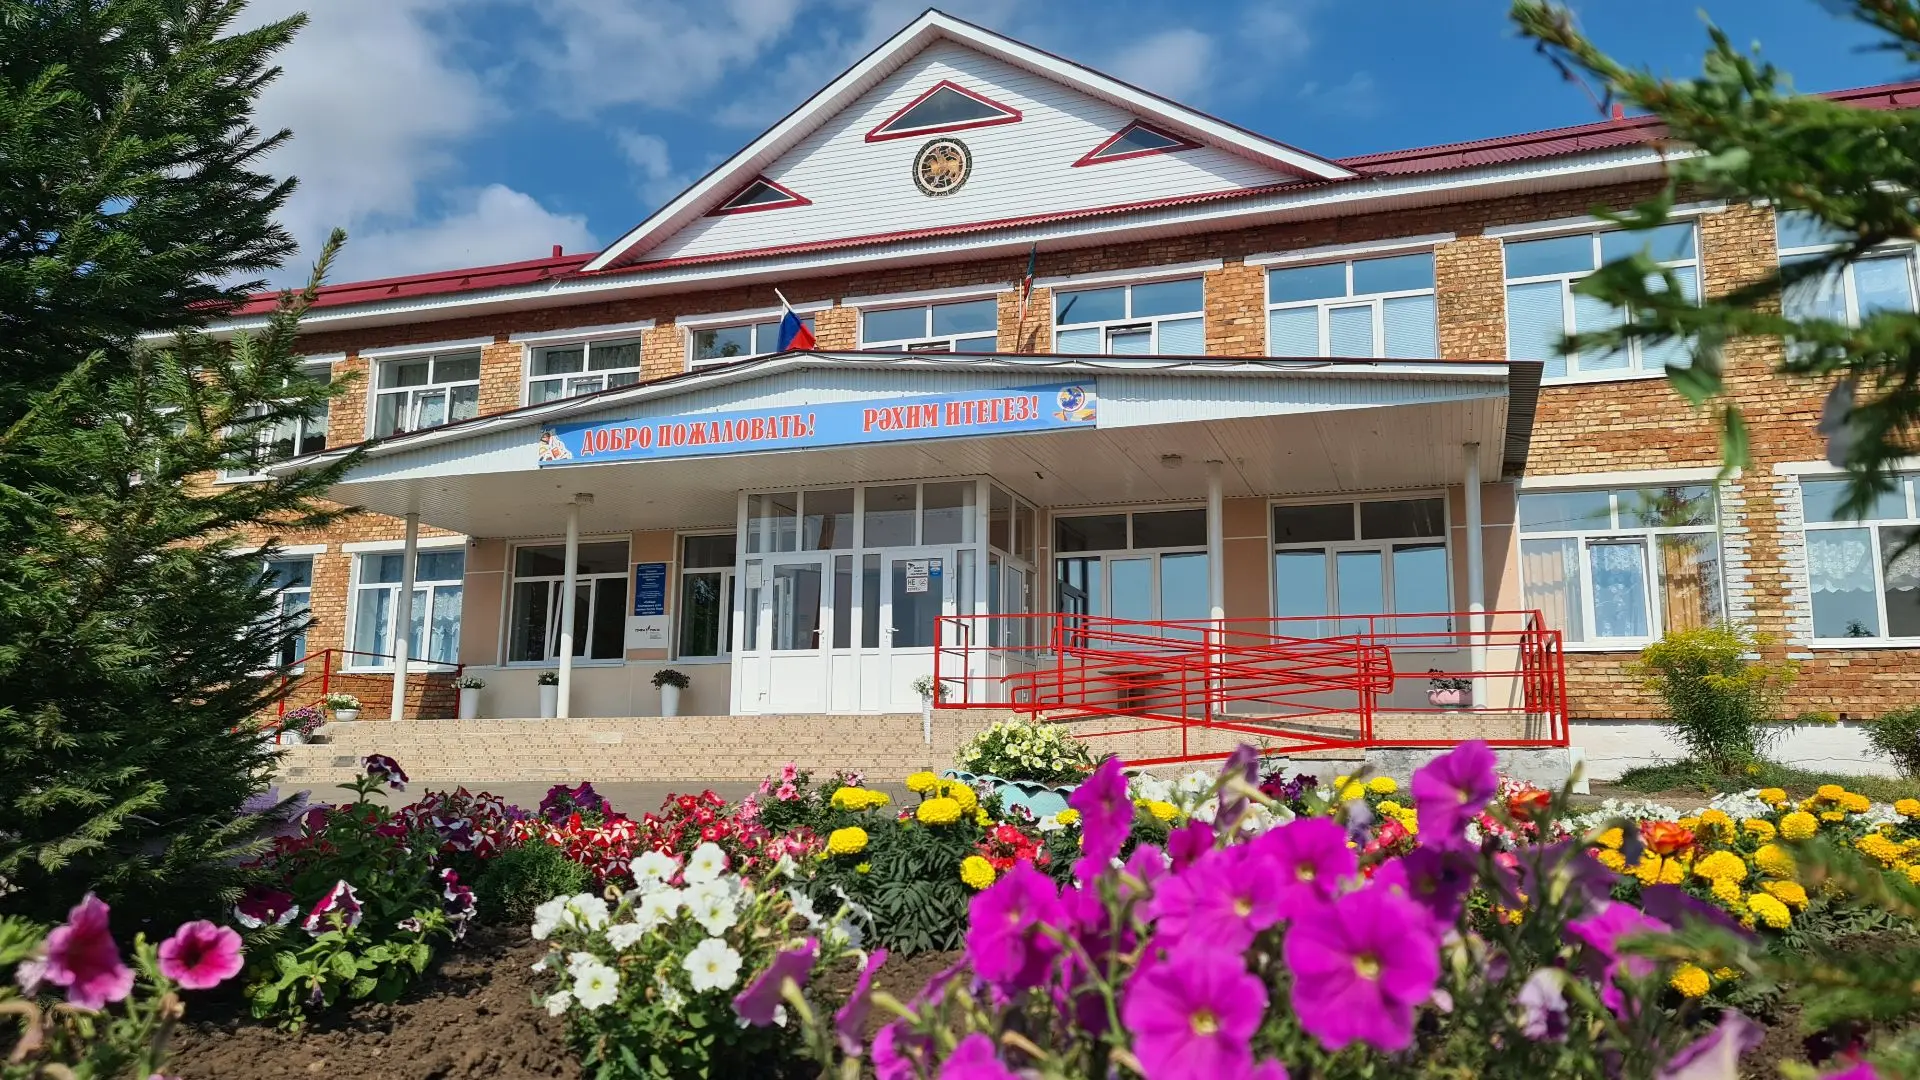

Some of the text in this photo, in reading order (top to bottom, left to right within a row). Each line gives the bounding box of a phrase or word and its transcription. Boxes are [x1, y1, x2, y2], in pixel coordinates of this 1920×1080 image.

[581, 395, 1039, 456] ДОБРО ПОЖАЛОВАТЬ! РӘХИМ ИТЕГЕЗ!
